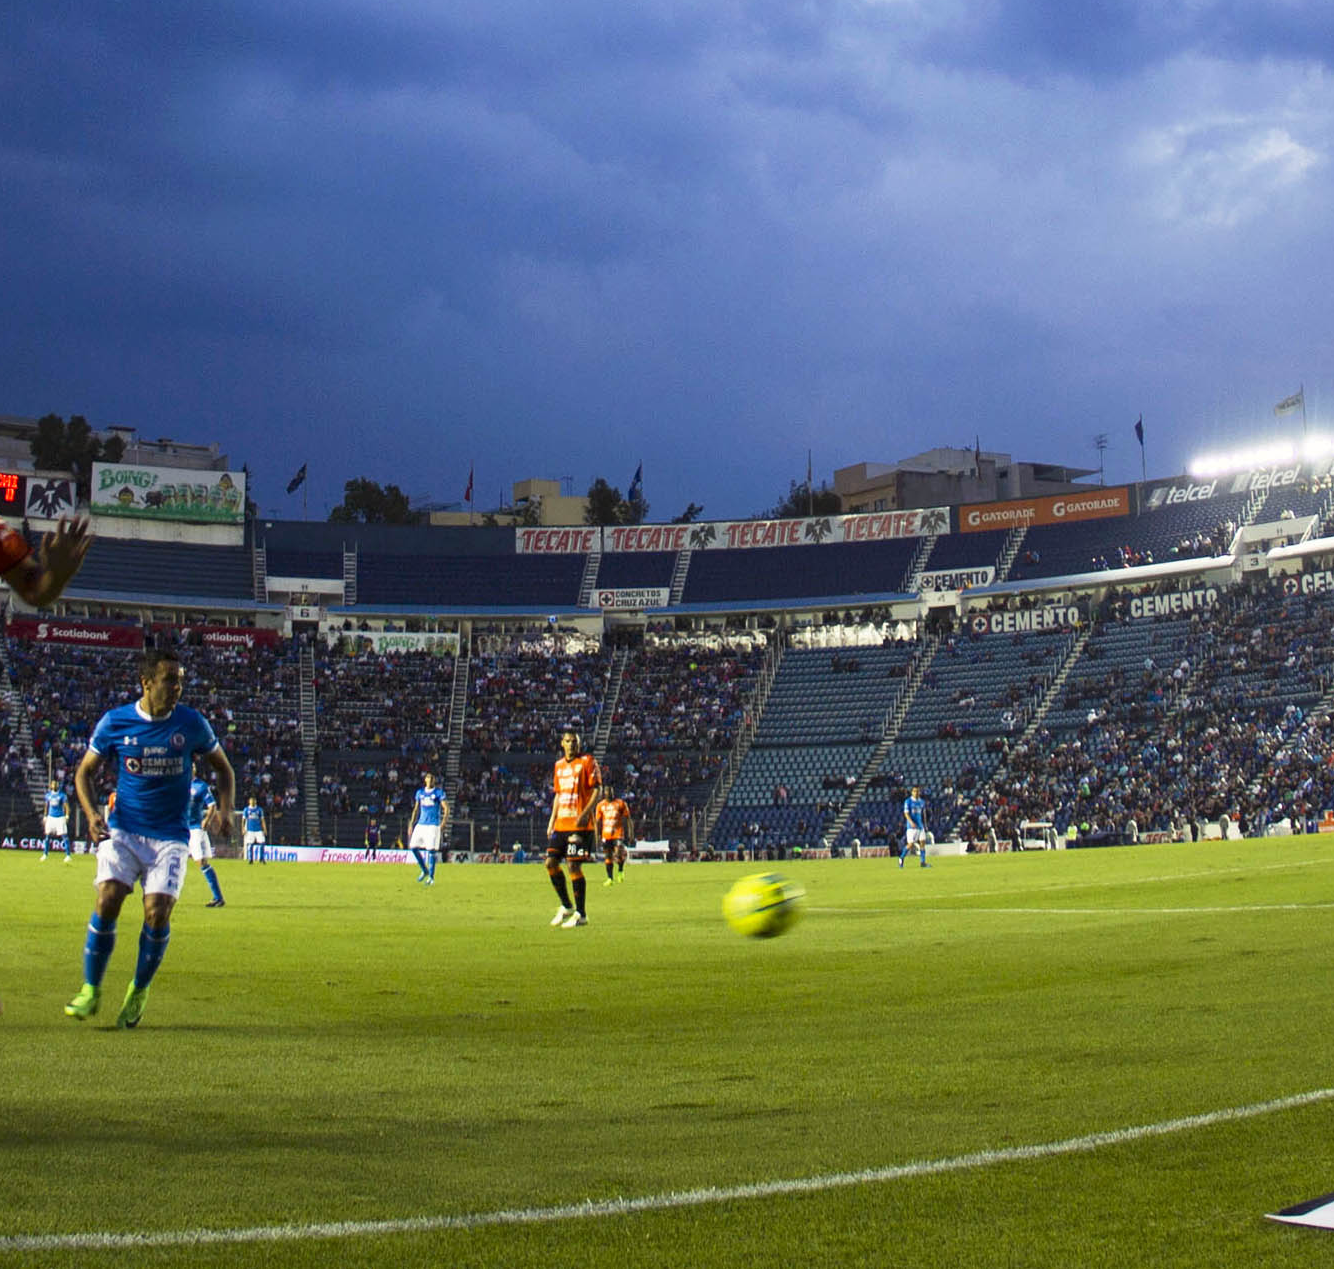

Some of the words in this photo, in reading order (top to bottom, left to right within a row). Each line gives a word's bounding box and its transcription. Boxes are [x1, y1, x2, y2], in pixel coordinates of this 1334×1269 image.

[1250, 465, 1302, 489] telcel
[1166, 480, 1218, 505] telcel
[982, 508, 1036, 523] GATORADE
[1066, 498, 1121, 513] GATORADE
[725, 520, 804, 547] TECATE
[843, 512, 919, 540] TECATE
[522, 531, 596, 551] TECATE
[612, 527, 688, 550] TECATE
[934, 570, 989, 590] CEMENTO
[615, 590, 662, 598] CONCRETOS
[615, 599, 637, 607] CRUZ
[638, 598, 660, 606] AZUL
[1131, 588, 1218, 619] CEMENTO
[991, 606, 1080, 632] CEMENTO
[52, 627, 112, 641] Scotiabank
[1, 837, 17, 849] AL
